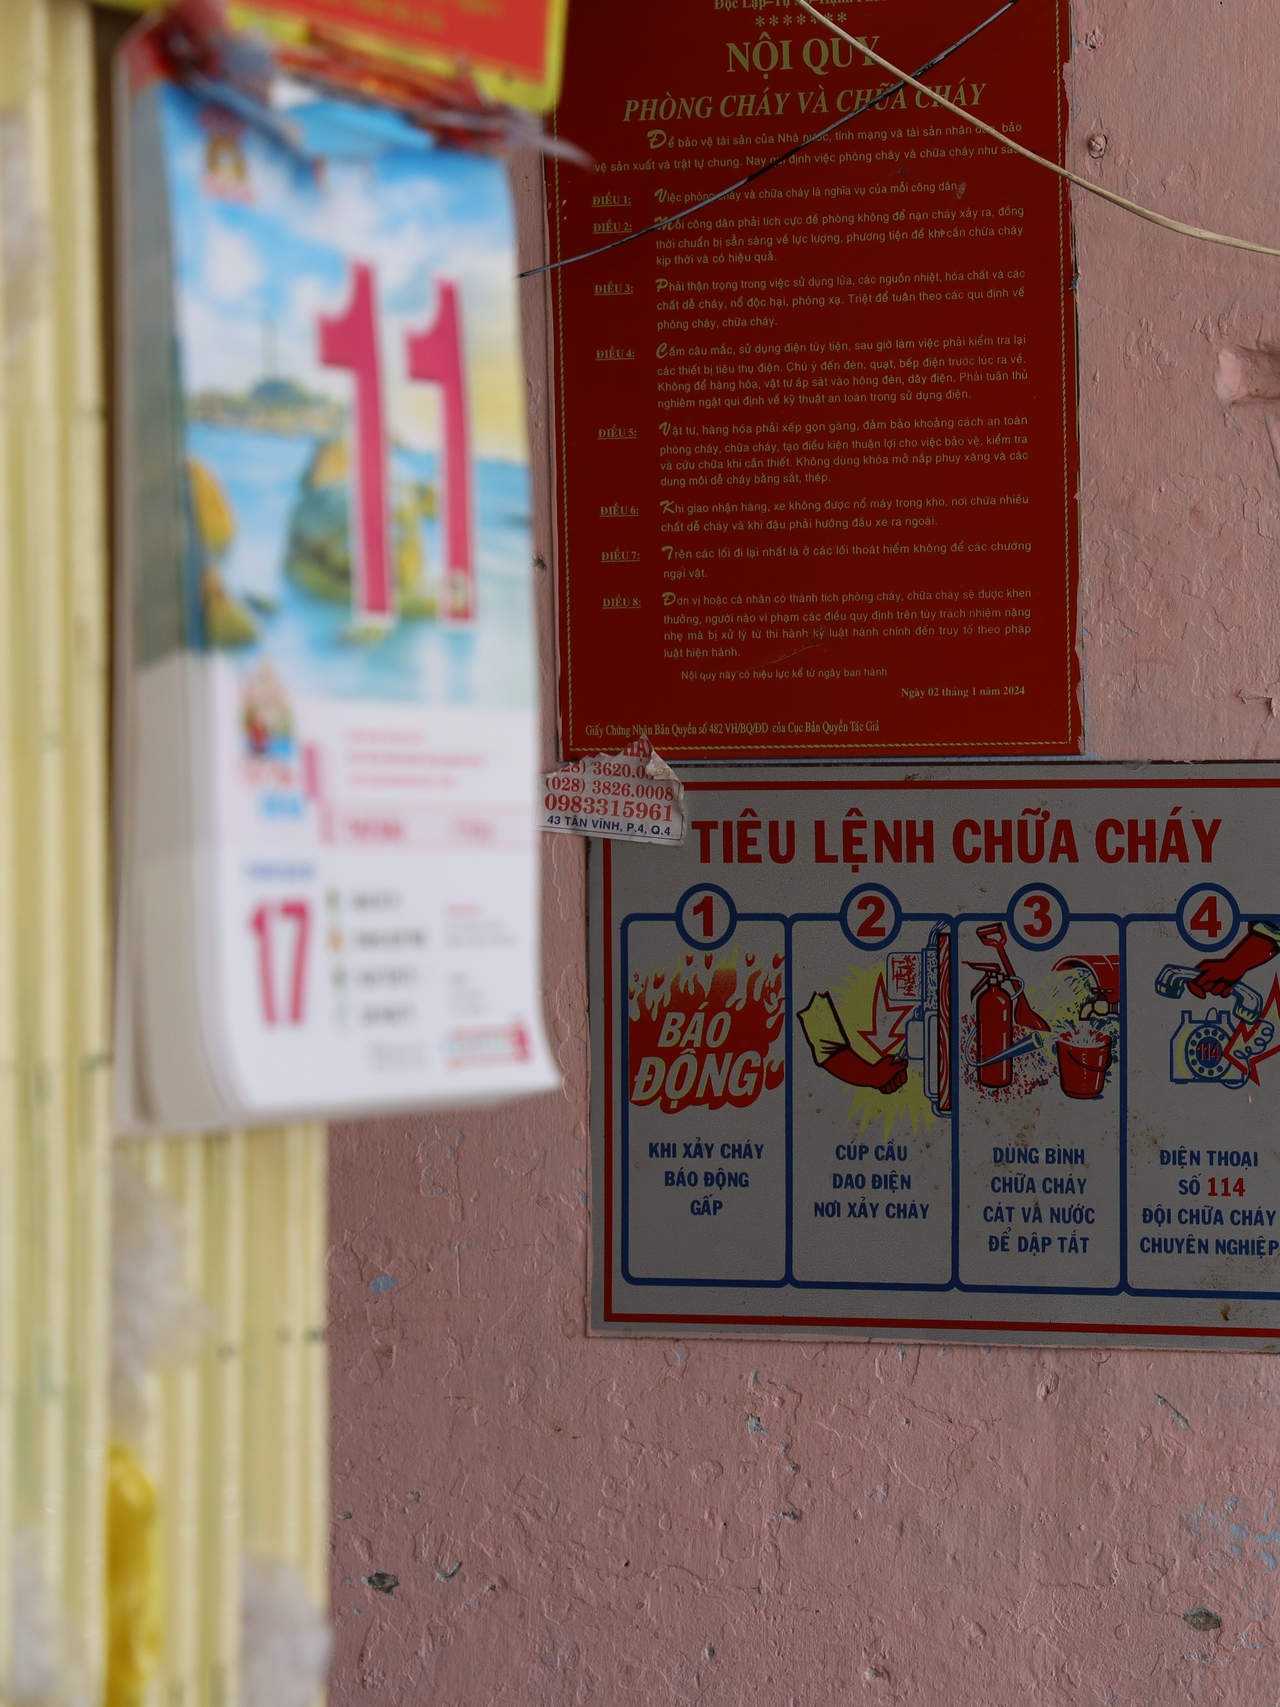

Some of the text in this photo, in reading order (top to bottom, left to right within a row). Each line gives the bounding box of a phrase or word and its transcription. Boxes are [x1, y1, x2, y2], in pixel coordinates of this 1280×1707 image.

[726, 31, 880, 80] NỘI QUY
[623, 77, 987, 122] PHÒNG CHÁY VÀ CHỮA CHÁY
[623, 196, 632, 205] 1:
[623, 222, 633, 232] 2:
[656, 250, 778, 268] kịp thời và có hiệu quả.
[624, 284, 634, 294] 3:
[657, 315, 778, 332] phòng cháy, chữa cháy.
[625, 349, 636, 359] 4:
[316, 260, 478, 623] 11
[628, 428, 638, 438] 5:
[660, 471, 831, 489] dung môi dễ cháy bằng sắt, thép.
[629, 506, 640, 516] 6:
[660, 515, 938, 533] chất dễ cháy và khi đậu phải hướng đầu xe ra ngoài.
[631, 551, 641, 561] 7:
[663, 566, 708, 581] ngại vật.
[632, 598, 642, 607] 8:
[663, 646, 741, 660] luật hiện hành.
[681, 666, 888, 682] Nội quy này có hiệu lực kể từ ngày ban hành
[901, 685, 1026, 700] Ngày 02 tháng 1 năm 2024
[584, 722, 604, 739] Giấy
[605, 724, 631, 739] Chứng
[654, 722, 670, 735] Bản
[671, 721, 698, 738] Quyền
[698, 721, 709, 735] số
[708, 722, 724, 735] 482
[771, 721, 787, 734] của
[787, 721, 804, 736] Cục
[804, 720, 821, 733] Bản
[821, 718, 849, 735] Quyền
[849, 720, 864, 732] Tác
[865, 719, 880, 732] Giả
[592, 761, 656, 781] 3620.0
[545, 776, 674, 801] (028) 3826.0008
[544, 793, 673, 822] 0983315961
[547, 815, 671, 836] 43 TÂN VĨNH, P.4, Q.4
[691, 806, 1222, 873] TIÊU LỆNH CHỮA CHÁY
[692, 895, 714, 937] 1
[856, 895, 886, 937] 2
[1022, 895, 1053, 937] 3
[1189, 896, 1223, 938] 4
[249, 897, 313, 1031] 17
[657, 1001, 732, 1049] BÁO
[1196, 1043, 1220, 1060] 114
[631, 1048, 760, 1109] ĐỘNG
[648, 1136, 764, 1159] KHI XẢY CHÁY
[835, 1139, 908, 1162] CÚP CẦU
[992, 1142, 1086, 1165] DÙNG BÌNH
[1160, 1145, 1259, 1170] ĐIỆN THOẠI
[664, 1166, 750, 1190] BÁO ĐỘNG
[832, 1169, 911, 1192] DAO ĐIỆN
[990, 1172, 1087, 1195] CHỮA CHÁY
[1178, 1173, 1246, 1198] SỐ 114
[690, 1195, 723, 1216] GẤP
[814, 1196, 930, 1219] NƠI XẢY CHÁY
[983, 1200, 1096, 1225] CÁT VÀ NƯỚC
[1141, 1203, 1277, 1228] ĐỘI CHỮA CHÁY
[988, 1226, 1090, 1257] ĐỂ DẬP TẮT
[1140, 1232, 1280, 1259] CHUYÊN NGHIỆP
